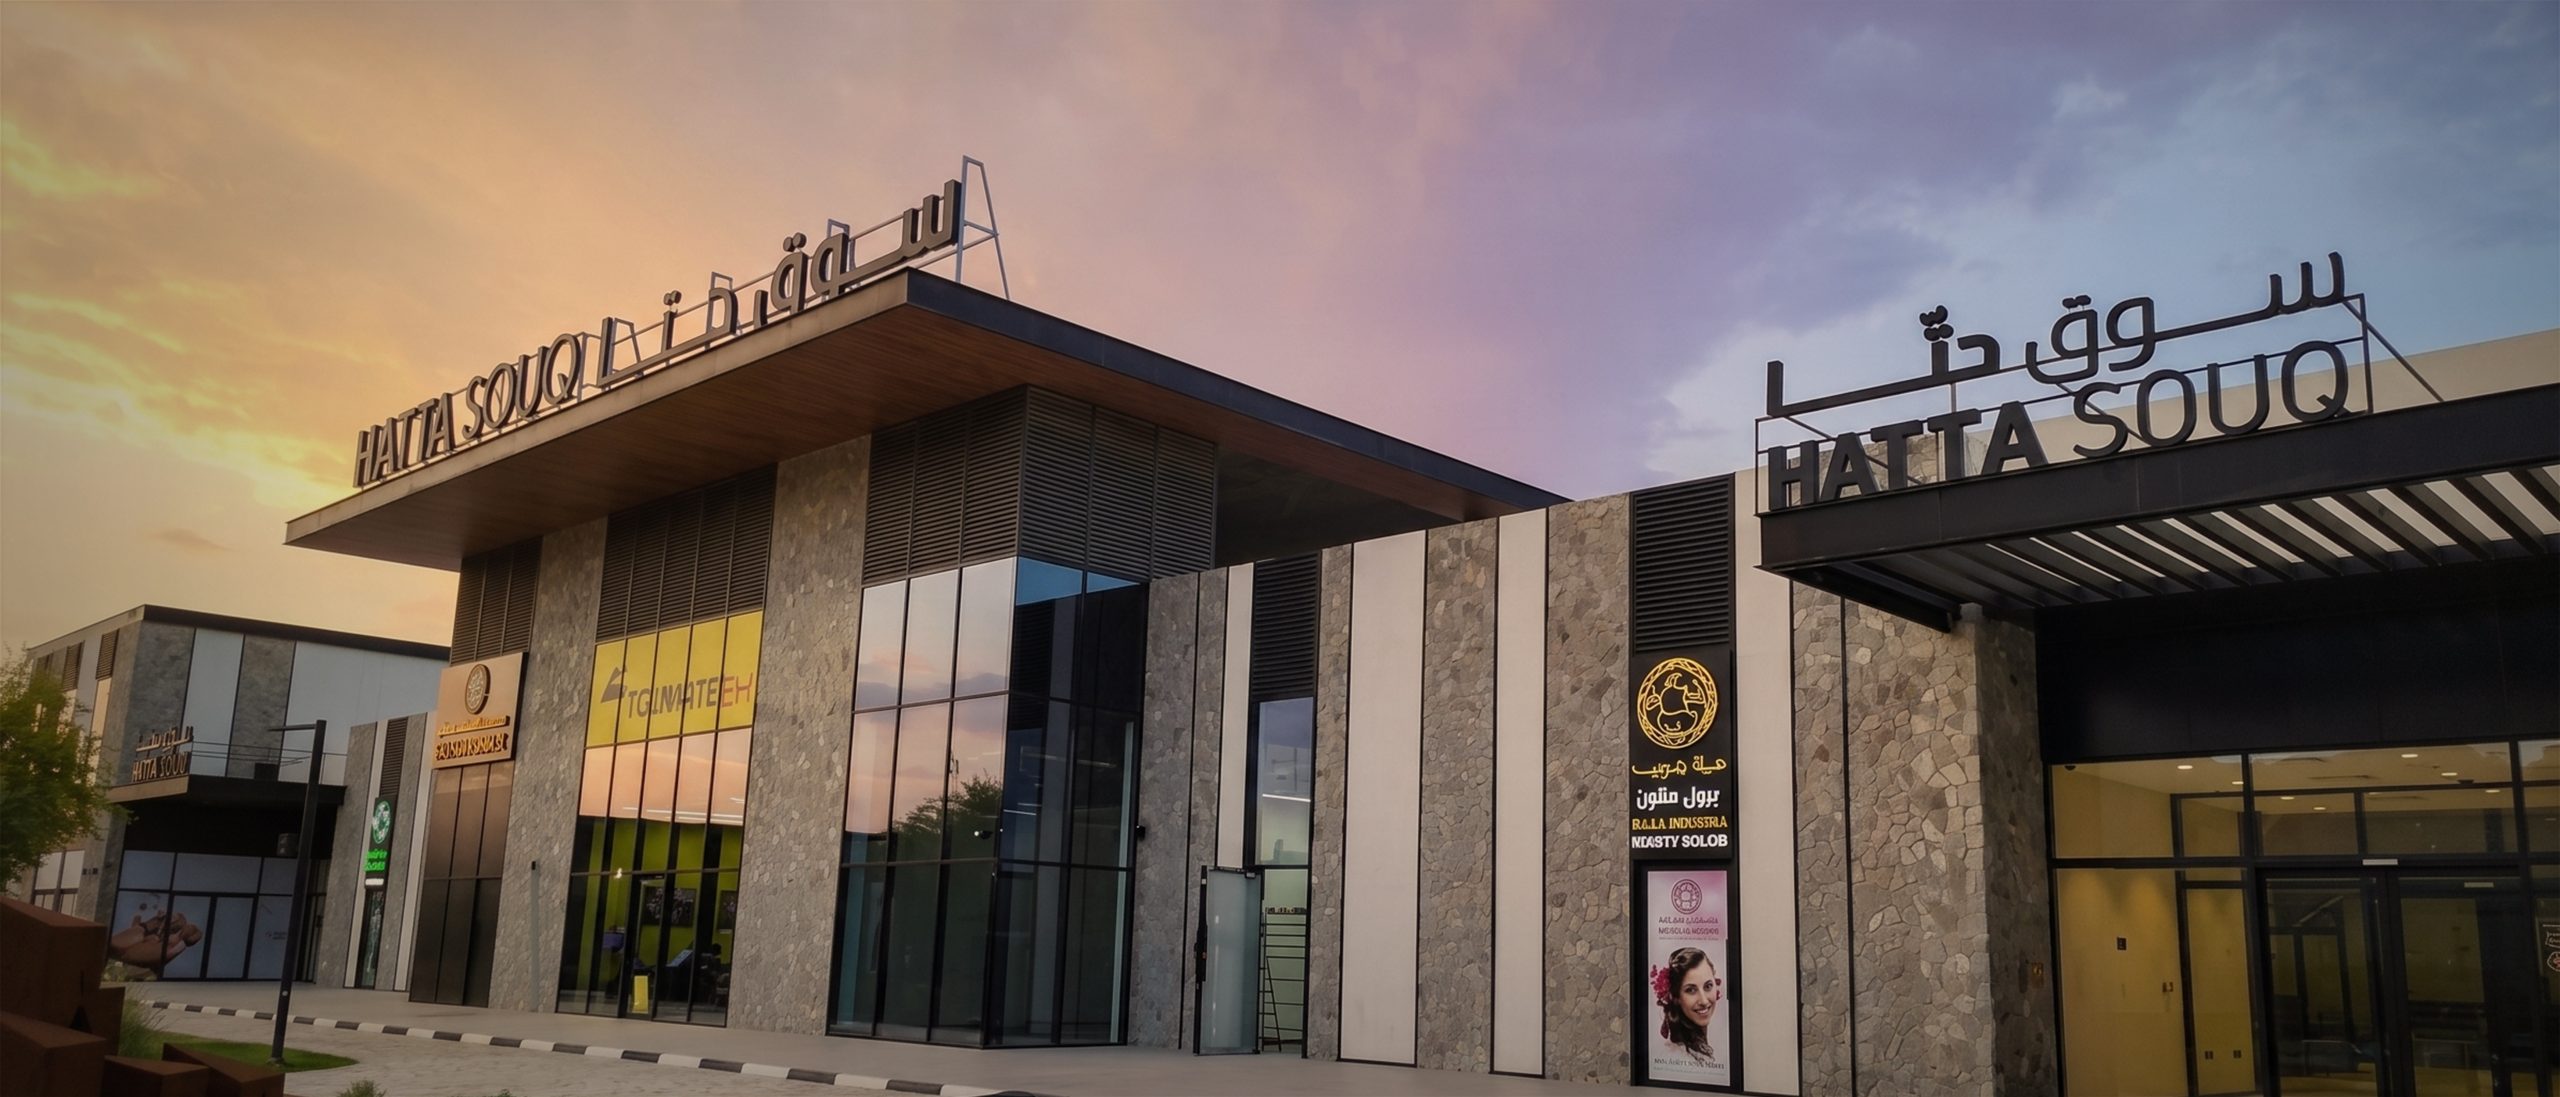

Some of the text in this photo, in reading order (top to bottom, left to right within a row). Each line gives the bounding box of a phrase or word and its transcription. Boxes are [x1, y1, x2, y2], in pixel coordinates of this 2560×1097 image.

[353, 333, 582, 488] HATTA SOUQ
[1767, 340, 2352, 512] HATTA SOUQ
[1681, 834, 1728, 848] SOLOB
